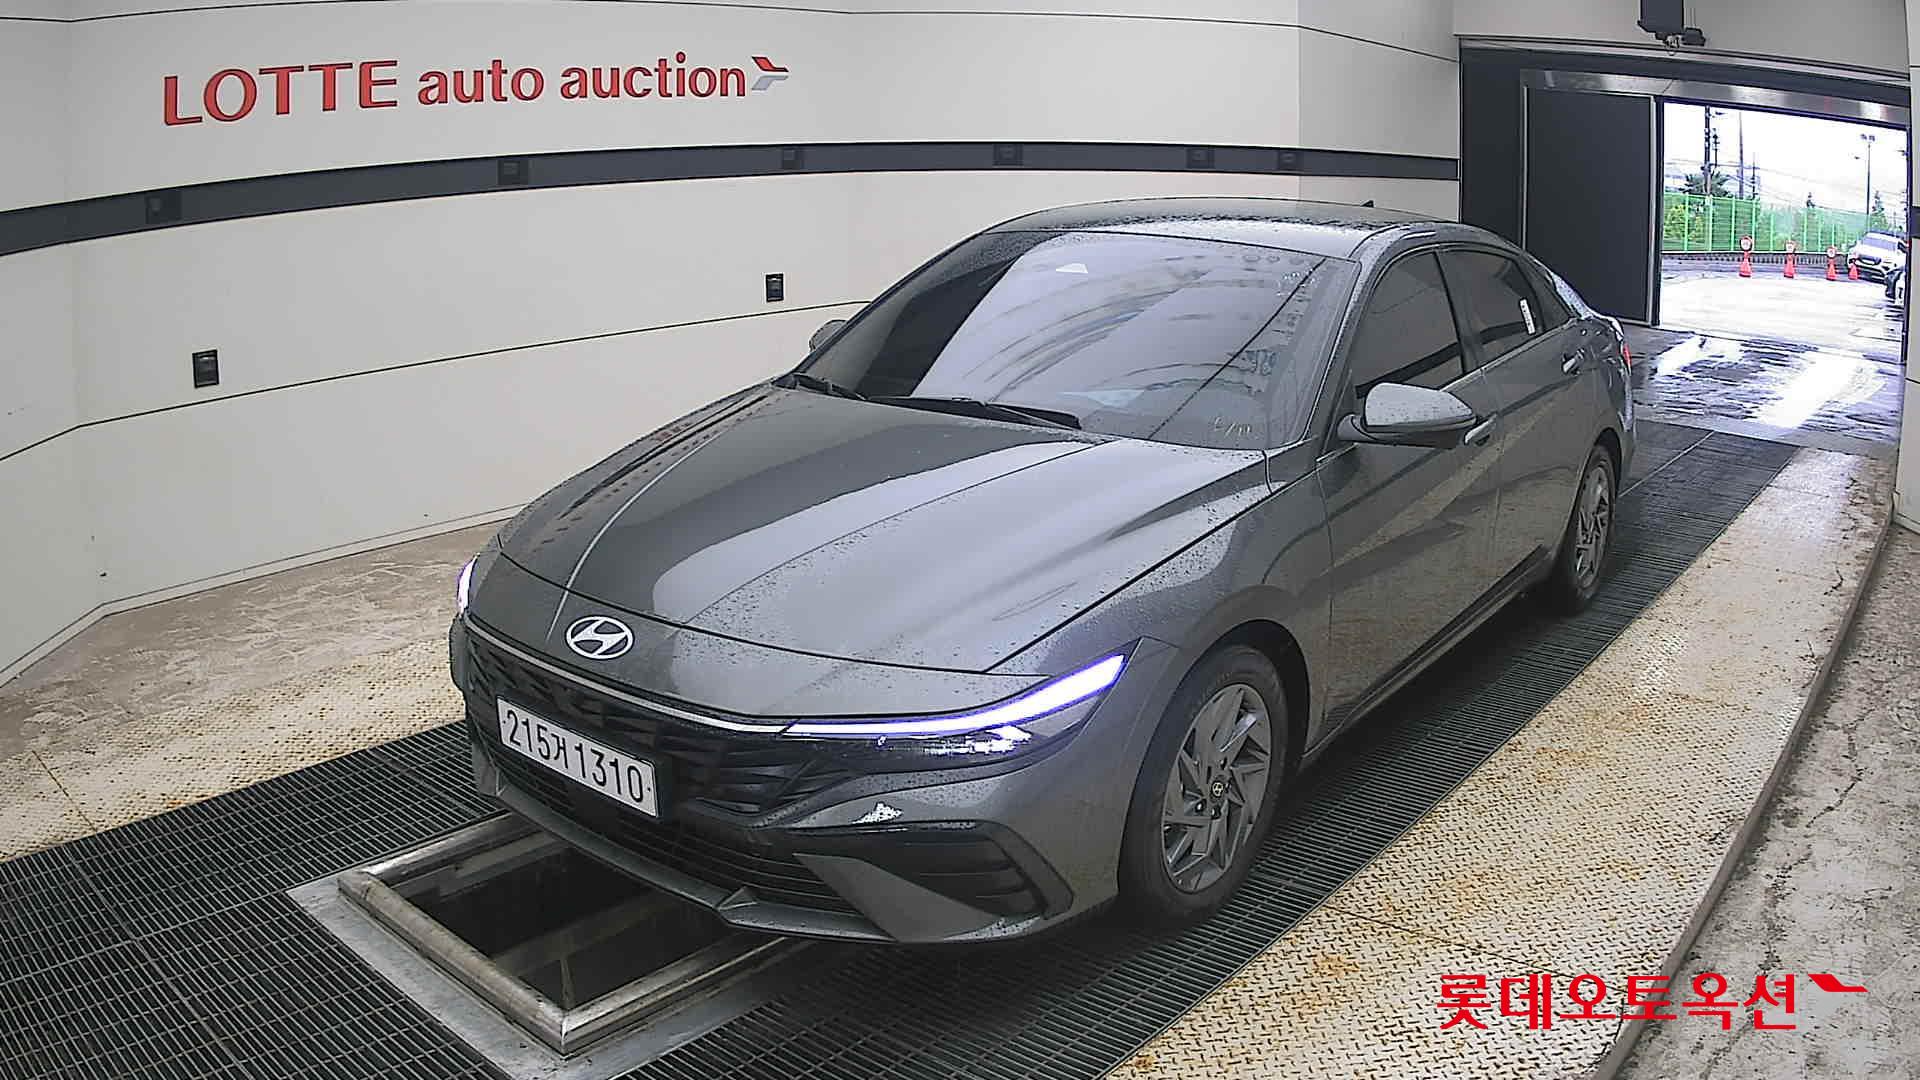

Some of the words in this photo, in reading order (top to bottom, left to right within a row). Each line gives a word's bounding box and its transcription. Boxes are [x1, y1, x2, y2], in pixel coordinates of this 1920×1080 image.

[163, 60, 399, 127] LOTTE
[417, 58, 546, 105] auto
[559, 51, 748, 98] auction
